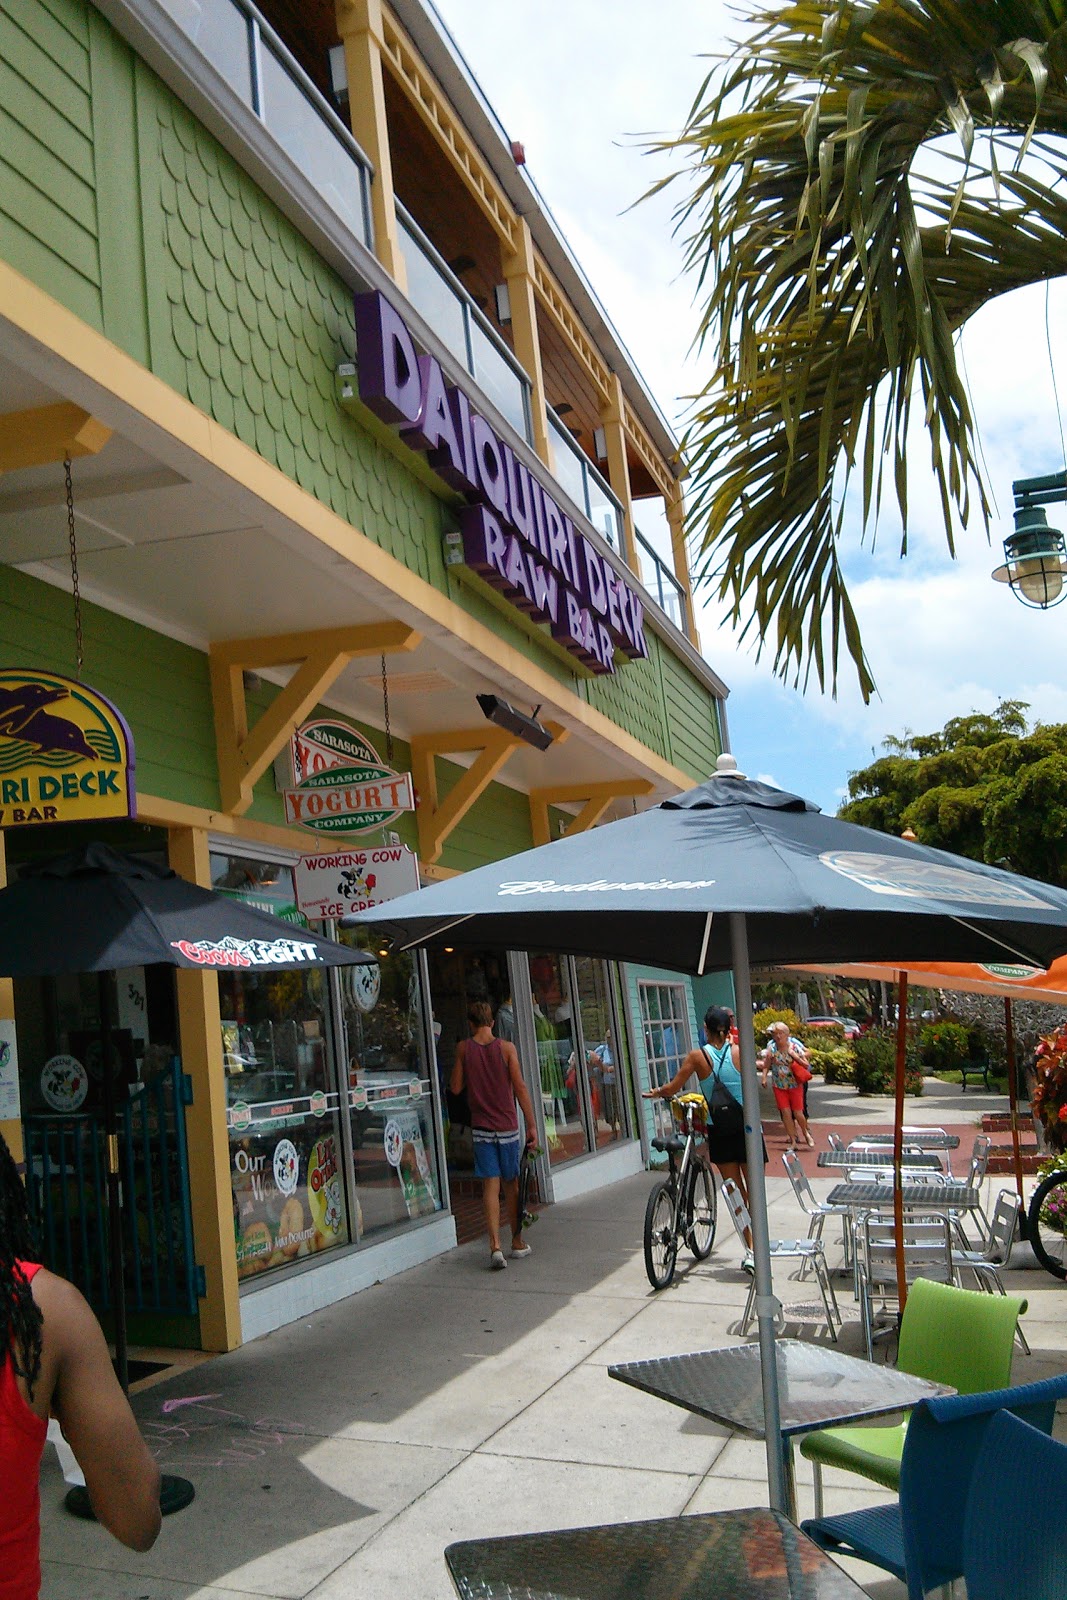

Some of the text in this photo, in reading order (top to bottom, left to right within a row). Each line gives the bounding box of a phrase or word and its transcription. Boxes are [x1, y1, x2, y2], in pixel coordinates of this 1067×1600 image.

[372, 290, 650, 659] DAIQUIRI DECK
[480, 506, 616, 674] RAW BAR
[313, 730, 372, 762] SARASOTA
[39, 769, 121, 800] DECK
[309, 770, 381, 787] SARASOTA
[287, 779, 406, 819] YOGURT
[13, 805, 58, 823] BAR
[314, 813, 385, 829] COMPANY
[304, 849, 402, 871] WORKING COW
[497, 878, 716, 896] Budweiser
[319, 898, 394, 917] ICE CRE
[171, 939, 318, 967] Coors LIGHT
[988, 964, 1030, 977] COMPANY
